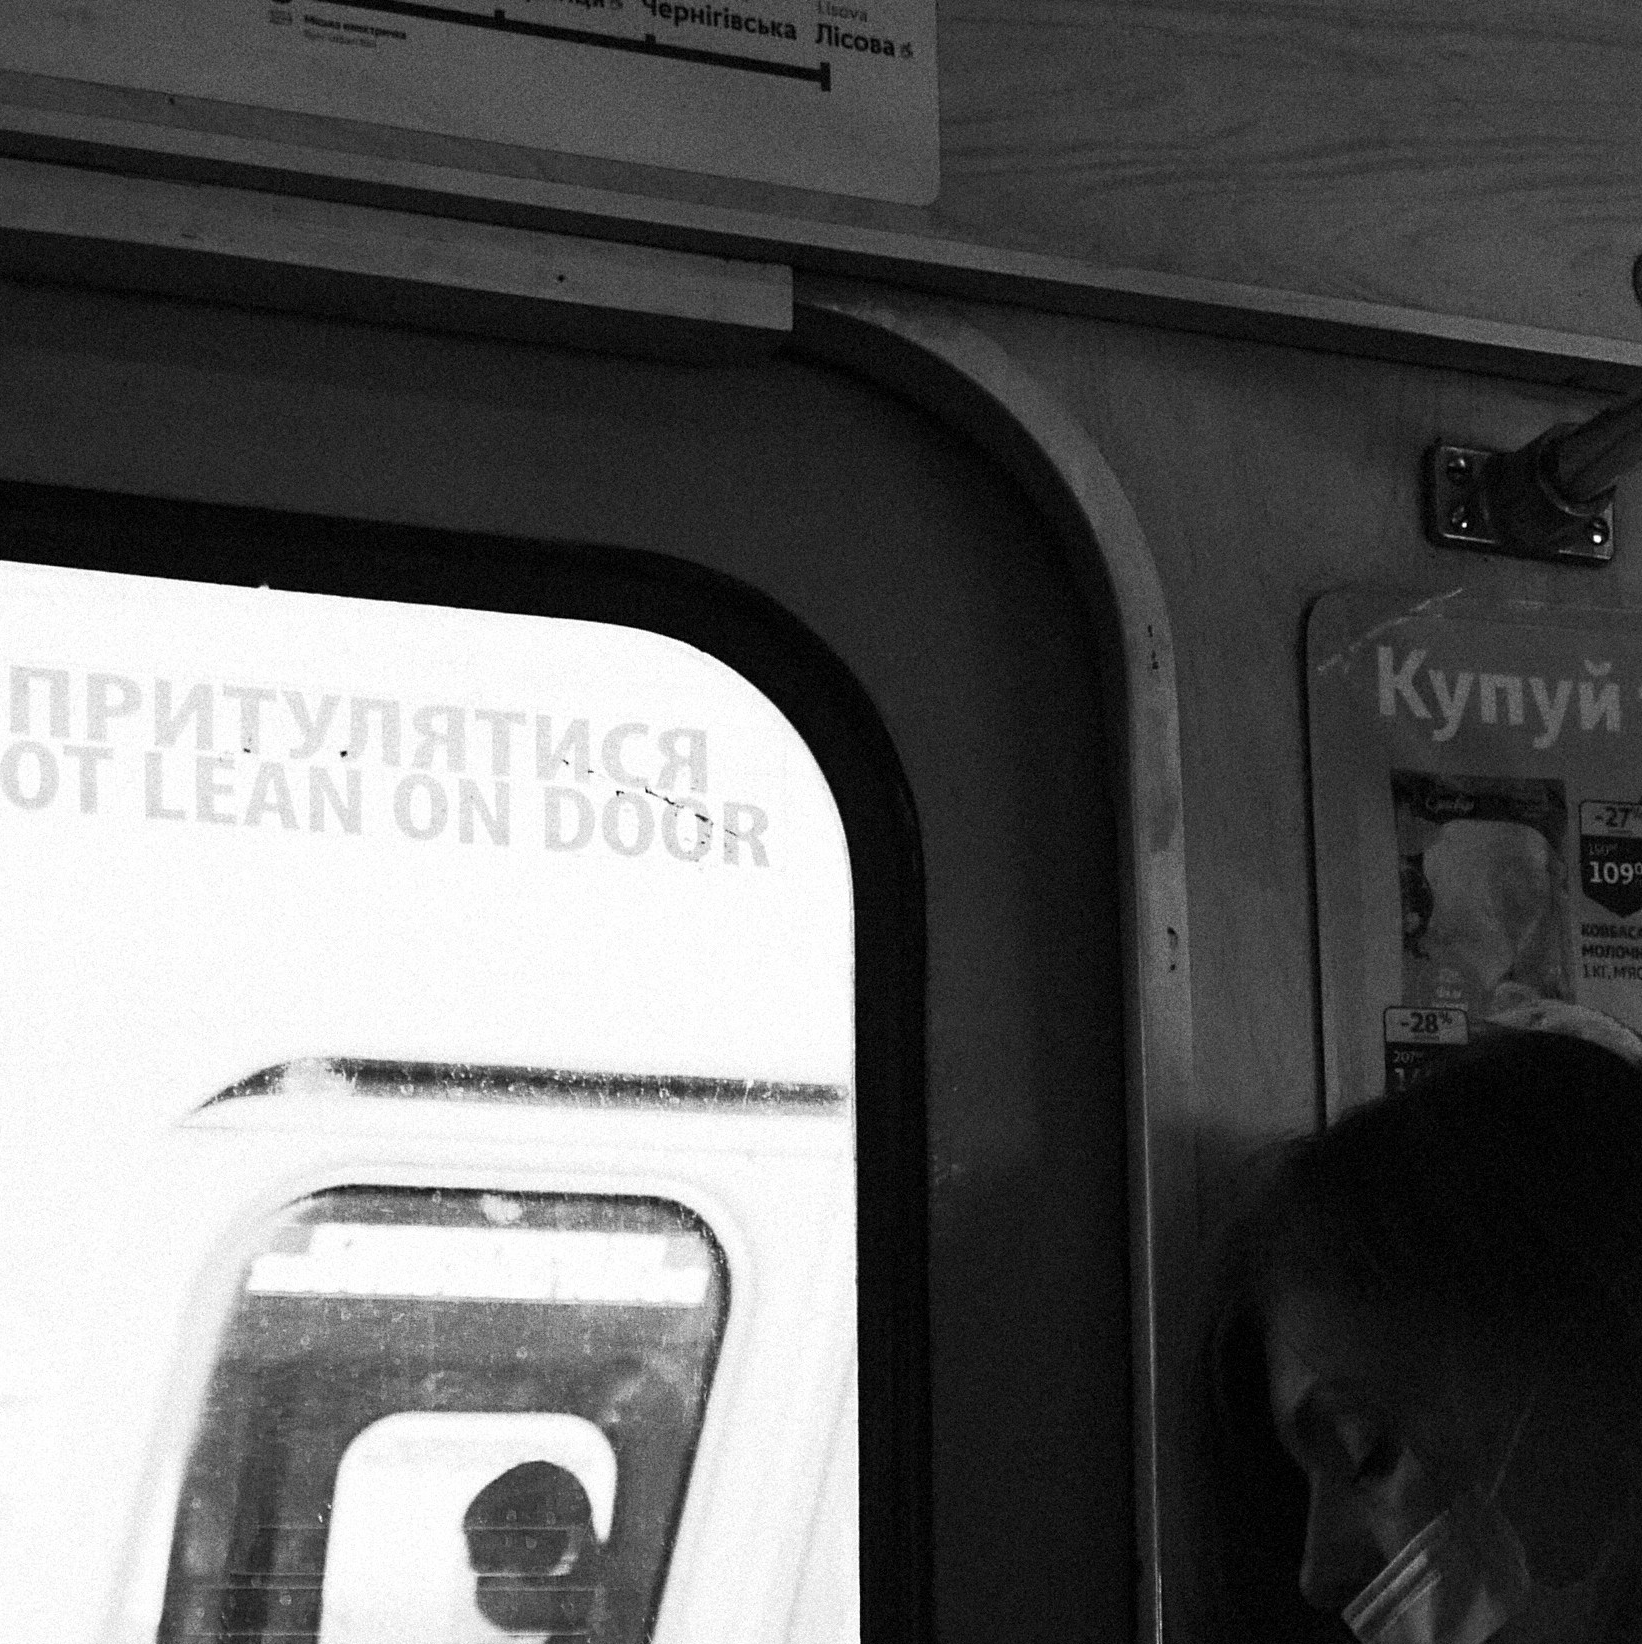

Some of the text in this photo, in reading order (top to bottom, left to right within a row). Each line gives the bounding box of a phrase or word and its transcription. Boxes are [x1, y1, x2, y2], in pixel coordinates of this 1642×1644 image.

[814, 23, 896, 58] Лісова
[8, 664, 710, 794] ПРИТУЛЯТИСЯ
[1376, 645, 1622, 750] Купуй
[142, 750, 367, 835] LEAN
[391, 772, 513, 849] ON
[541, 787, 772, 871] DOOR
